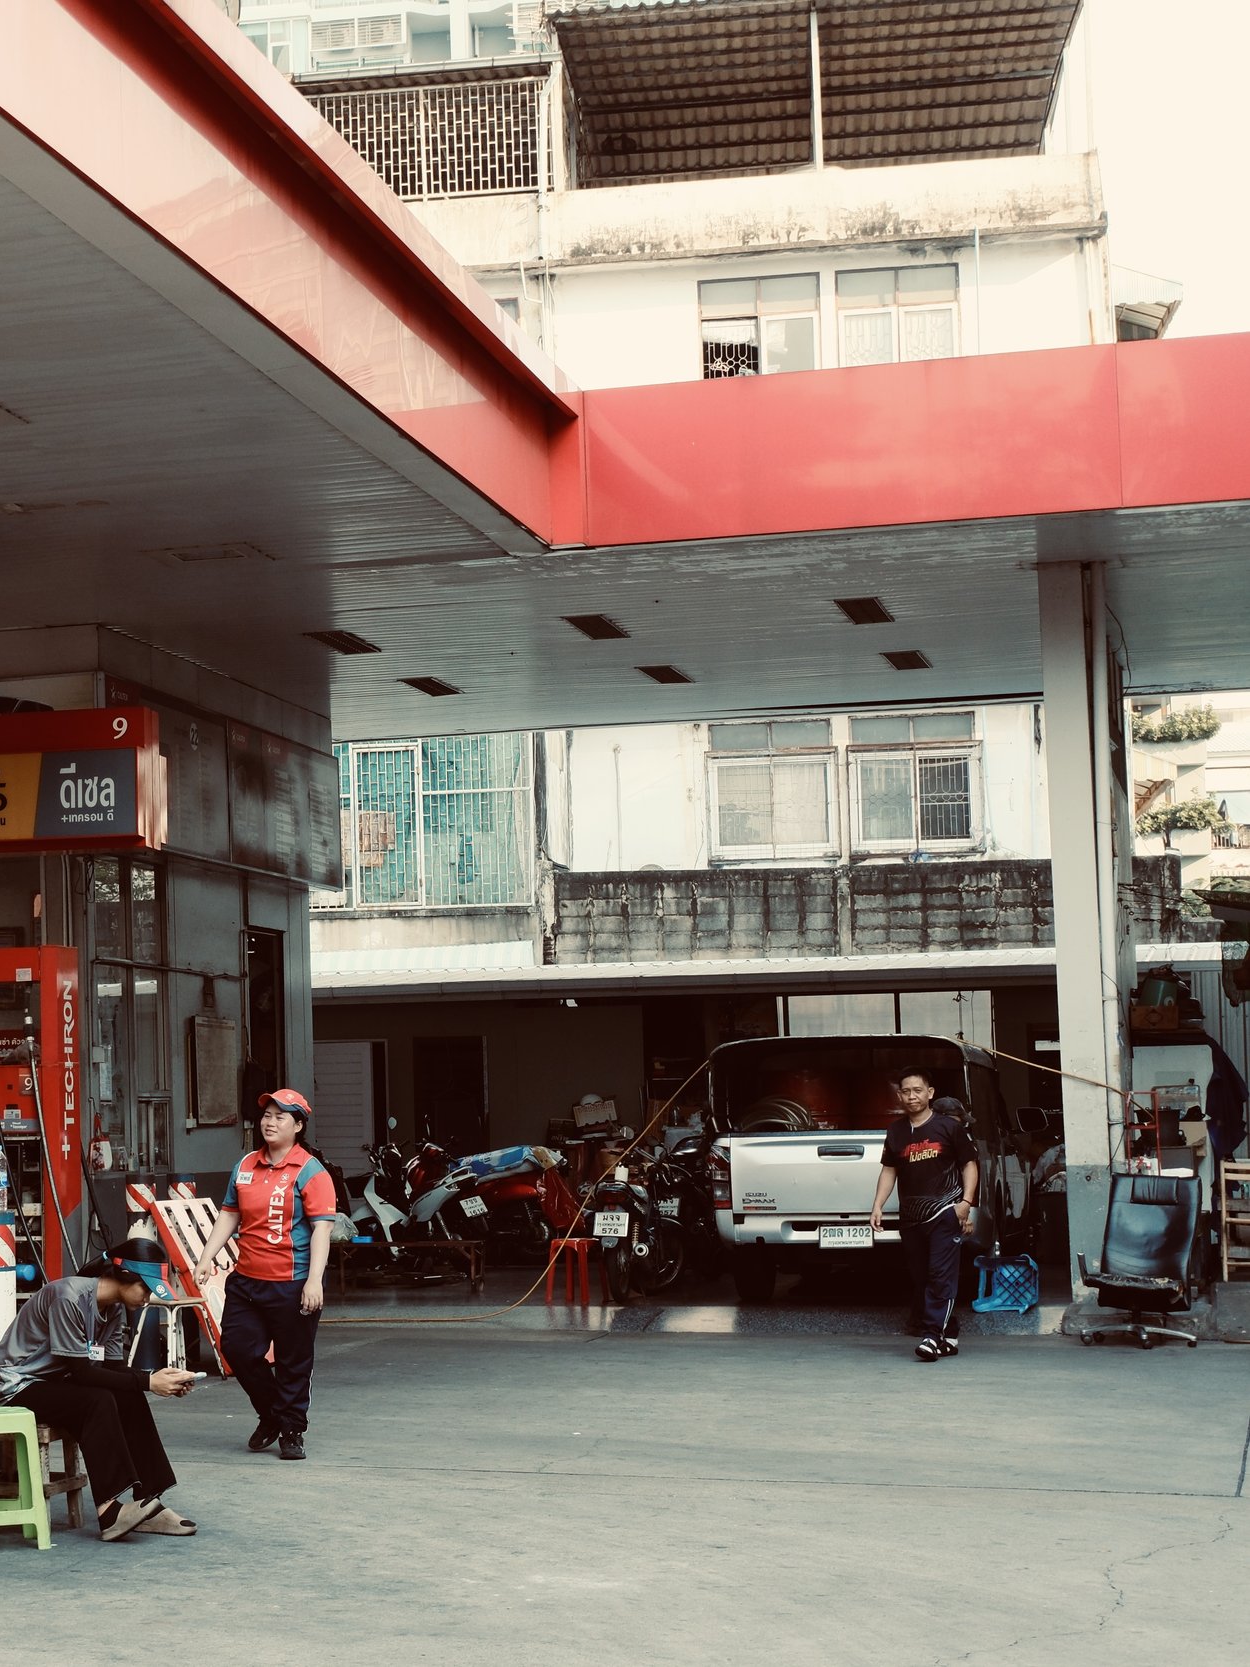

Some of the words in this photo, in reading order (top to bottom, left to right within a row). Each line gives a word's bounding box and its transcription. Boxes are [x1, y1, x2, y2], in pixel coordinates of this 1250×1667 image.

[112, 717, 128, 740] 9
[59, 762, 116, 809] ดีเซล
[61, 812, 103, 824] +เทครอน
[107, 810, 114, 821] ดี
[24, 1077, 33, 1091] 9
[267, 1184, 288, 1245] CALTEX
[601, 1227, 619, 1235] 576
[847, 1227, 871, 1238] 1202
